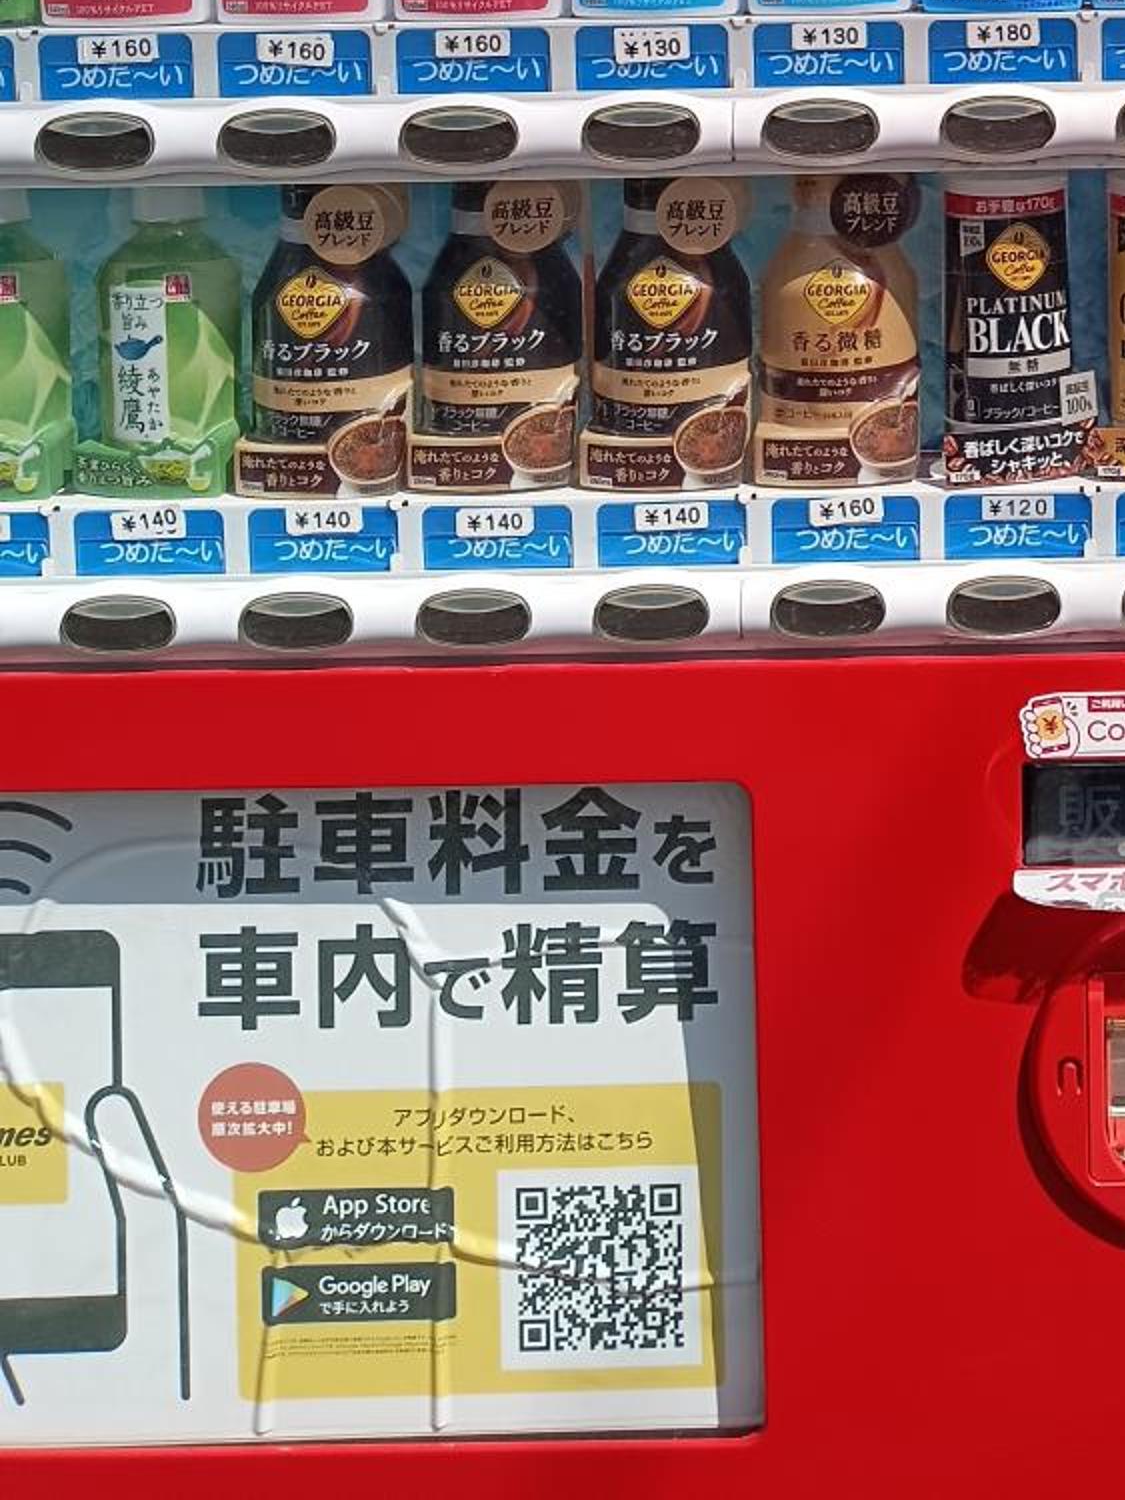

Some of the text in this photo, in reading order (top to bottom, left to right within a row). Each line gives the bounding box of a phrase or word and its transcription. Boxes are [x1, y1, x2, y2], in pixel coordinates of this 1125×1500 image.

[976, 21, 1033, 44] ¥180
[623, 36, 683, 58] ¥130
[313, 210, 375, 232] 高級豆
[490, 198, 554, 222] 高級豆
[664, 199, 725, 223] 高級豆
[318, 230, 372, 247] ブレンド
[497, 219, 551, 236] ブレンド
[668, 220, 723, 238] ブレンド
[281, 293, 342, 309] GEORGIA
[966, 288, 1068, 316] PLATINUM
[121, 312, 148, 331] 旨み
[966, 310, 1071, 355] BLACK
[262, 339, 371, 363] 香るブラック
[436, 329, 546, 353] 香るブラック
[610, 327, 719, 352] 香るブラック
[791, 327, 882, 353] 香る微糖
[117, 363, 144, 434] 綾鷹
[147, 368, 164, 432] あやたか
[963, 429, 1086, 459] 香ばしく深いコクで
[991, 451, 1072, 475] シャキッと、
[265, 473, 324, 488] 香りとコク
[988, 497, 1048, 517] ¥120
[195, 786, 717, 899] 駐車料金を
[197, 919, 720, 1031] 車内で精算
[210, 1098, 298, 1117] 使える駐車場
[210, 1120, 294, 1138] 順次拡大中!
[315, 1130, 654, 1159] および本サービスご利用方法はこちら
[322, 1194, 431, 1220] App Store
[320, 1222, 455, 1243] からダウンロード
[318, 1274, 432, 1299] Google Play
[319, 1298, 411, 1316] で手に入れよう
